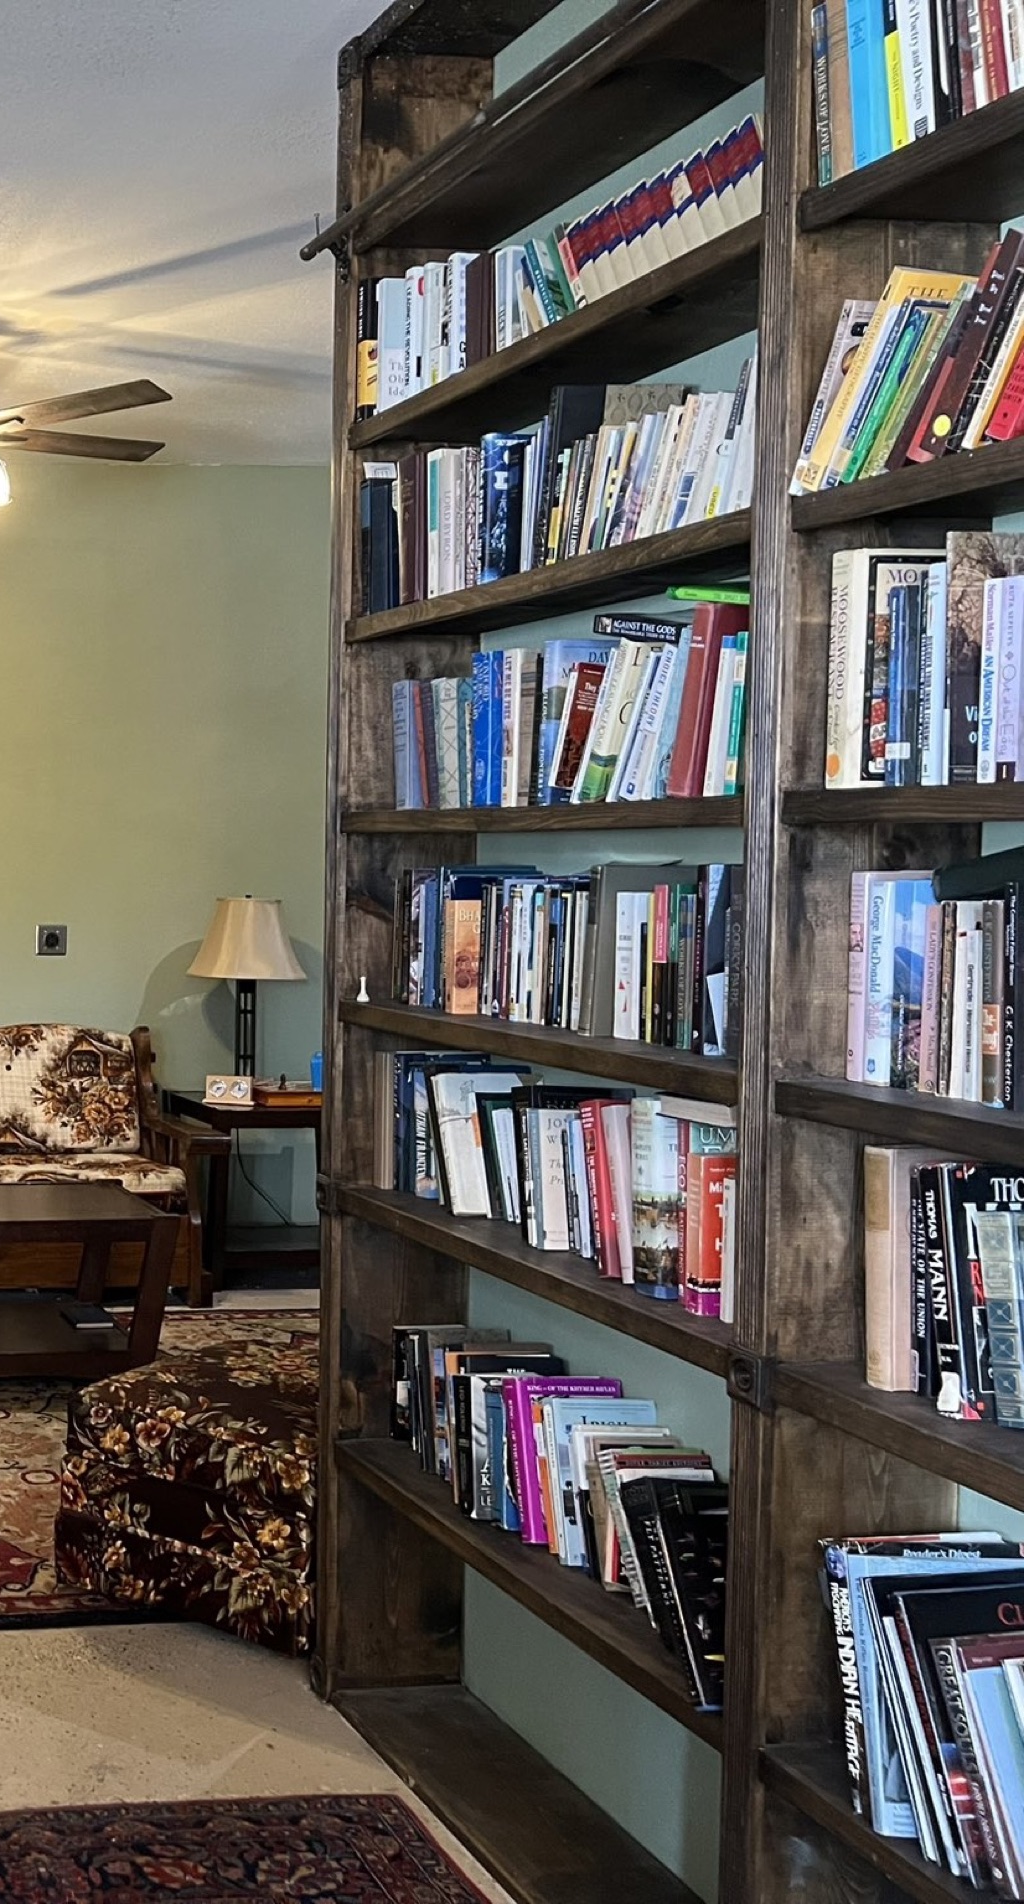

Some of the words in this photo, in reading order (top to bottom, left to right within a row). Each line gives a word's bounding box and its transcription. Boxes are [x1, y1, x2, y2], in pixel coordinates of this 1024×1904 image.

[909, 12, 921, 47] Poetry
[912, 50, 922, 68] and
[816, 55, 828, 101] WORKS
[912, 69, 924, 110] Designs
[818, 102, 829, 117] OF
[818, 120, 831, 153] LOVE
[443, 490, 452, 521] LORD
[708, 491, 718, 515] USED
[443, 523, 452, 562] BYRON
[986, 583, 997, 622] Norman
[613, 620, 641, 632] AGAINST
[641, 623, 656, 632] THE
[656, 624, 677, 634] GODS
[835, 584, 849, 700] MOOSEWOOD
[985, 622, 996, 652] Mailer
[657, 649, 675, 686] CHOICE
[984, 654, 994, 668] AN
[645, 690, 664, 728] THEORY
[982, 668, 995, 717] AMERICAN
[981, 717, 994, 752] DREAM
[872, 895, 885, 932] George
[1007, 896, 1017, 909] The
[1007, 909, 1015, 940] Complete
[678, 937, 686, 976] WORKS
[731, 922, 741, 971] GORKY
[926, 931, 938, 960] LADY'S
[1008, 941, 1016, 963] Father
[869, 933, 882, 994] MacDonald
[982, 931, 992, 1002] CHESTERTON
[678, 977, 686, 992] OF
[731, 972, 741, 1007] PARK
[925, 960, 937, 1012] CONFESSION
[677, 993, 685, 1020] LOVE
[1005, 1005, 1014, 1016] G.
[1005, 1020, 1014, 1033] K.
[1004, 1034, 1014, 1102] Chesterton
[415, 1140, 427, 1179] FRANZEN
[678, 1155, 687, 1188] ECO
[924, 1189, 938, 1239] THOMAS
[916, 1222, 926, 1255] STATE
[916, 1259, 926, 1274] OF
[916, 1278, 926, 1299] THE
[927, 1248, 948, 1321] MANN
[916, 1302, 926, 1339] UNION
[527, 1385, 543, 1393] KING
[510, 1430, 517, 1442] OF
[643, 1519, 657, 1542] FLY
[903, 1548, 948, 1558] Reader's
[948, 1548, 981, 1558] Digest
[648, 1545, 671, 1607] PATTERNS
[829, 1582, 843, 1636] FASCINATING
[838, 1587, 853, 1632] AMERICA'S
[836, 1635, 861, 1698] INDIAN
[936, 1650, 963, 1709] GREAT
[951, 1712, 978, 1774] SOULS
[843, 1698, 864, 1781] HERITAGE
